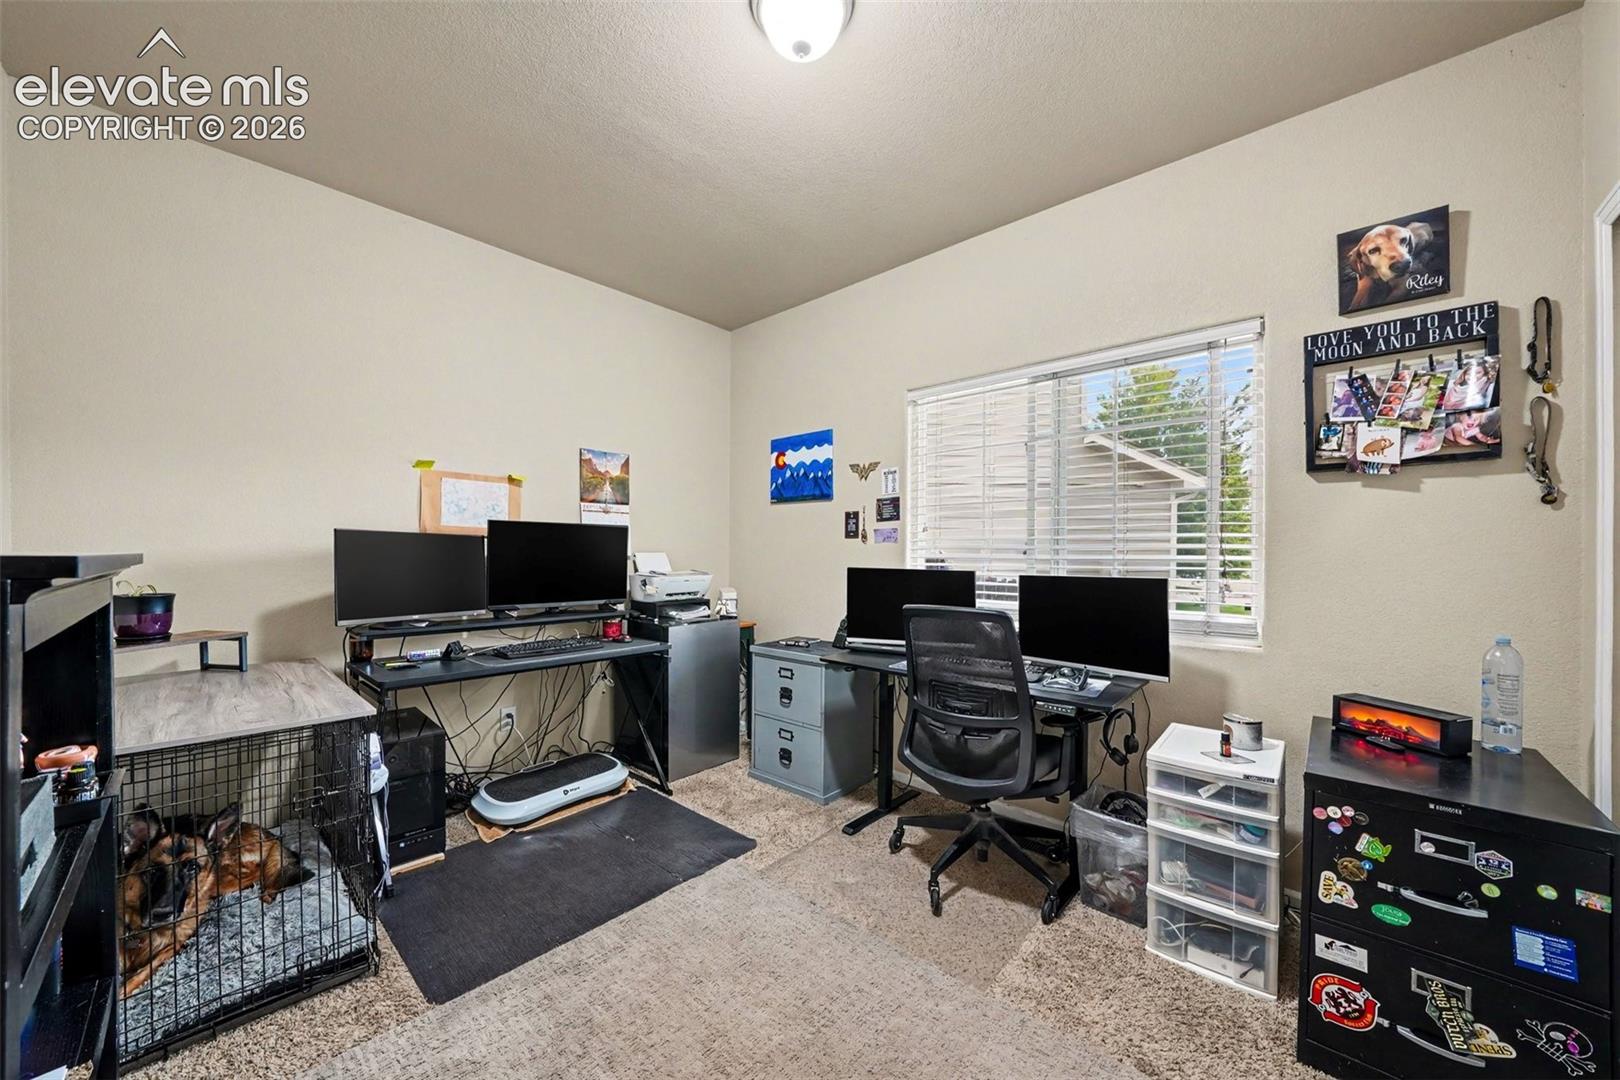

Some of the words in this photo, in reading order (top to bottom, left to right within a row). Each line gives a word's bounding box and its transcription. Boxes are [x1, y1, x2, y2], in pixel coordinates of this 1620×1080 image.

[1406, 273, 1445, 289] Riley
[1307, 330, 1353, 350] LOVE
[1364, 320, 1402, 339] YOU
[1413, 314, 1439, 331] TO
[1450, 303, 1495, 324] THE
[1314, 341, 1363, 362] MOON
[1375, 332, 1416, 352] AND
[1428, 319, 1486, 343] BACK
